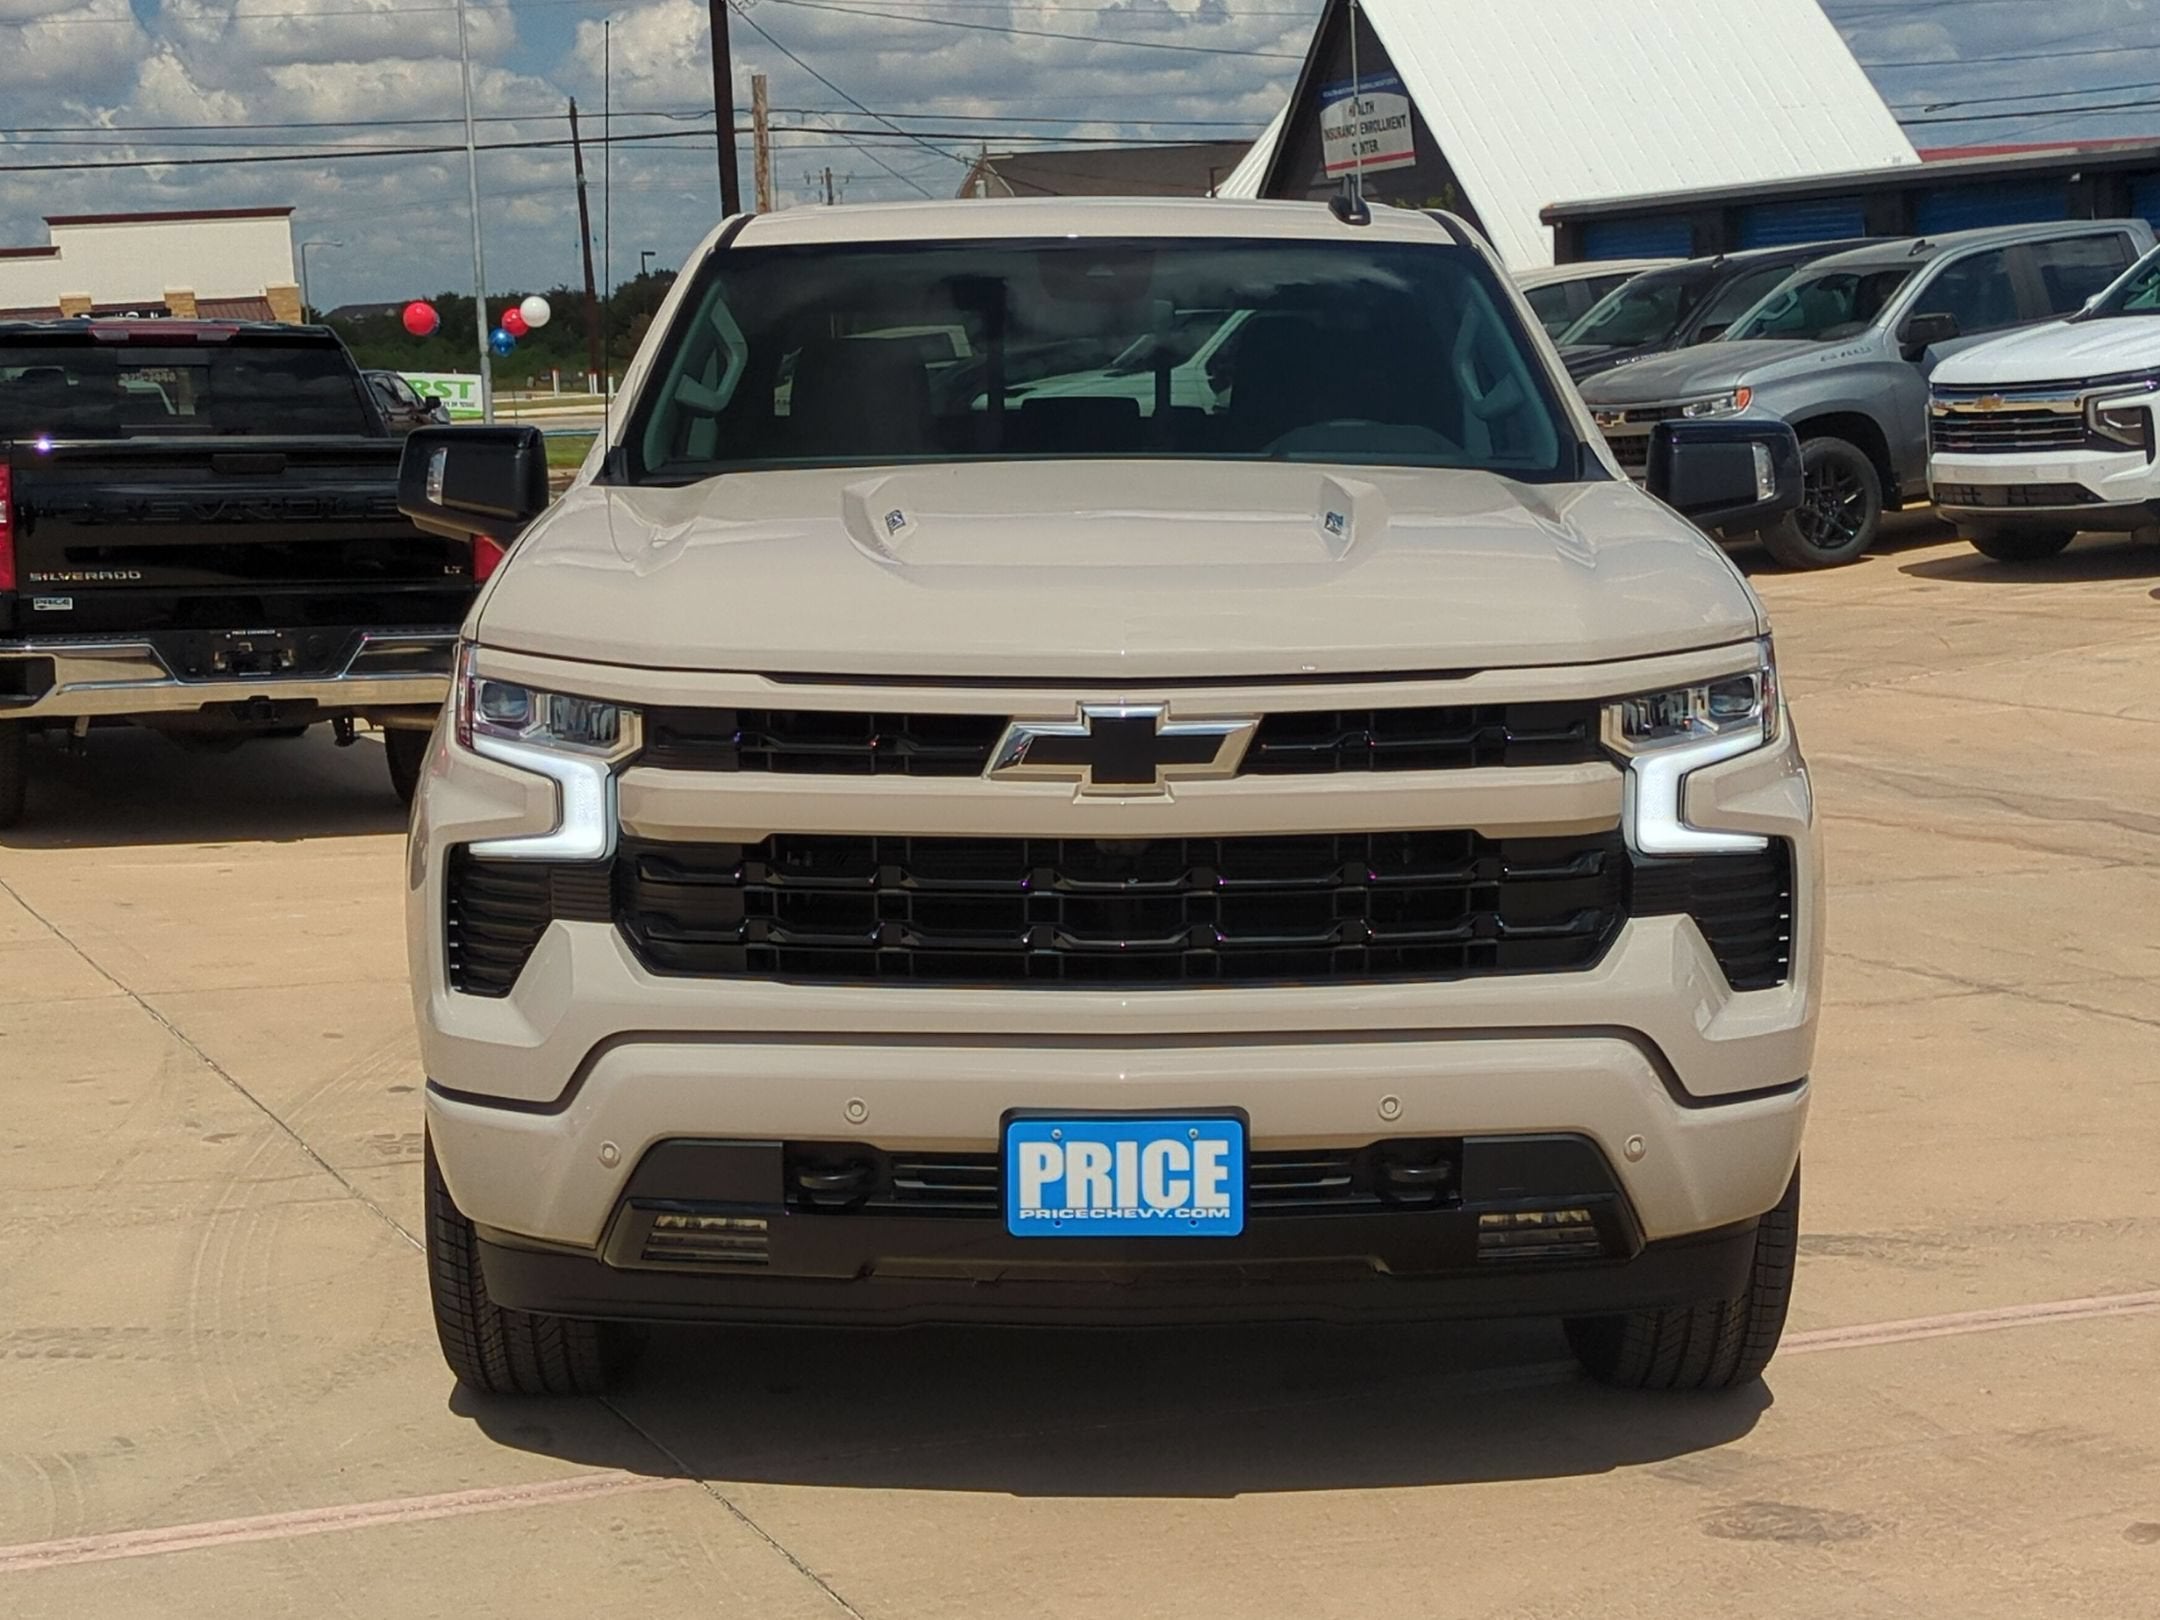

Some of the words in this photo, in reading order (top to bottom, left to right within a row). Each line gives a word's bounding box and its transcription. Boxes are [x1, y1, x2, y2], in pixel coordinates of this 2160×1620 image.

[1352, 139, 1379, 156] CNTER
[29, 570, 141, 582] SILVERADO
[1019, 1139, 1230, 1208] PRICE
[1019, 1207, 1230, 1219] PRICECHEVY.COM
